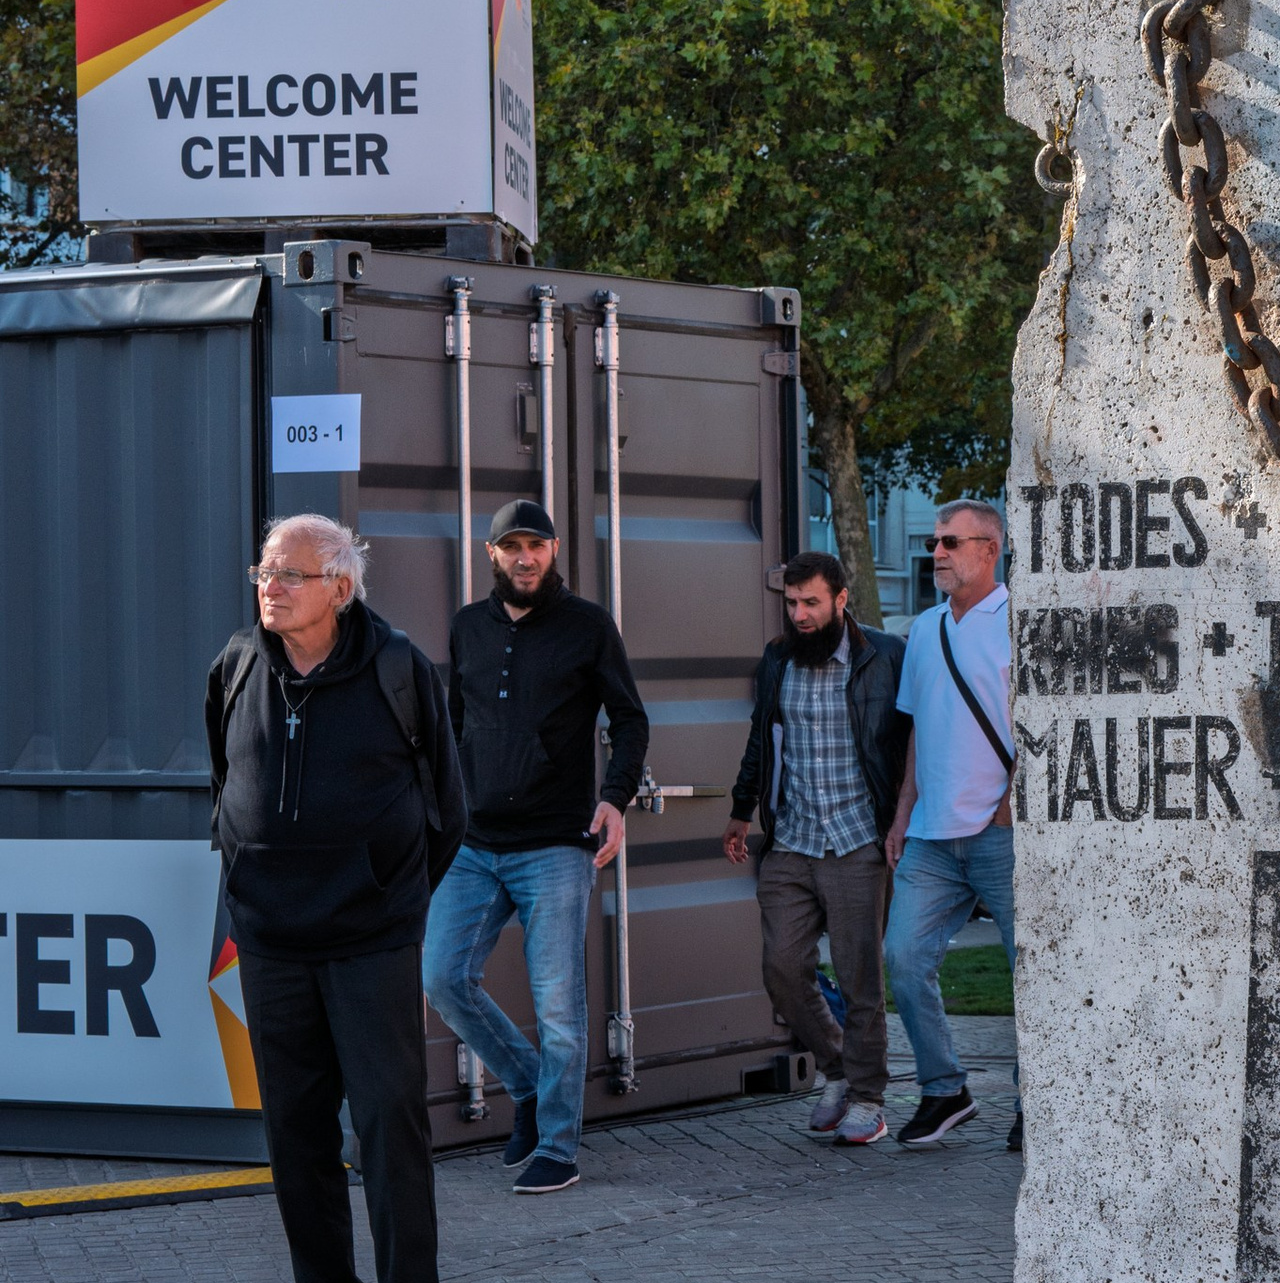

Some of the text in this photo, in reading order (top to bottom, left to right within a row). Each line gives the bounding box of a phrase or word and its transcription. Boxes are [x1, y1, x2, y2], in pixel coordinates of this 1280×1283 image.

[148, 72, 418, 119] WELCOME
[499, 78, 531, 150] WELCOME
[180, 133, 390, 180] CENTER
[504, 141, 530, 203] CENTER
[287, 425, 318, 443] 003
[335, 424, 343, 441] 1
[1019, 476, 1209, 574] TODES
[1015, 714, 1244, 823] MAUER
[0, 912, 162, 1038] ER
